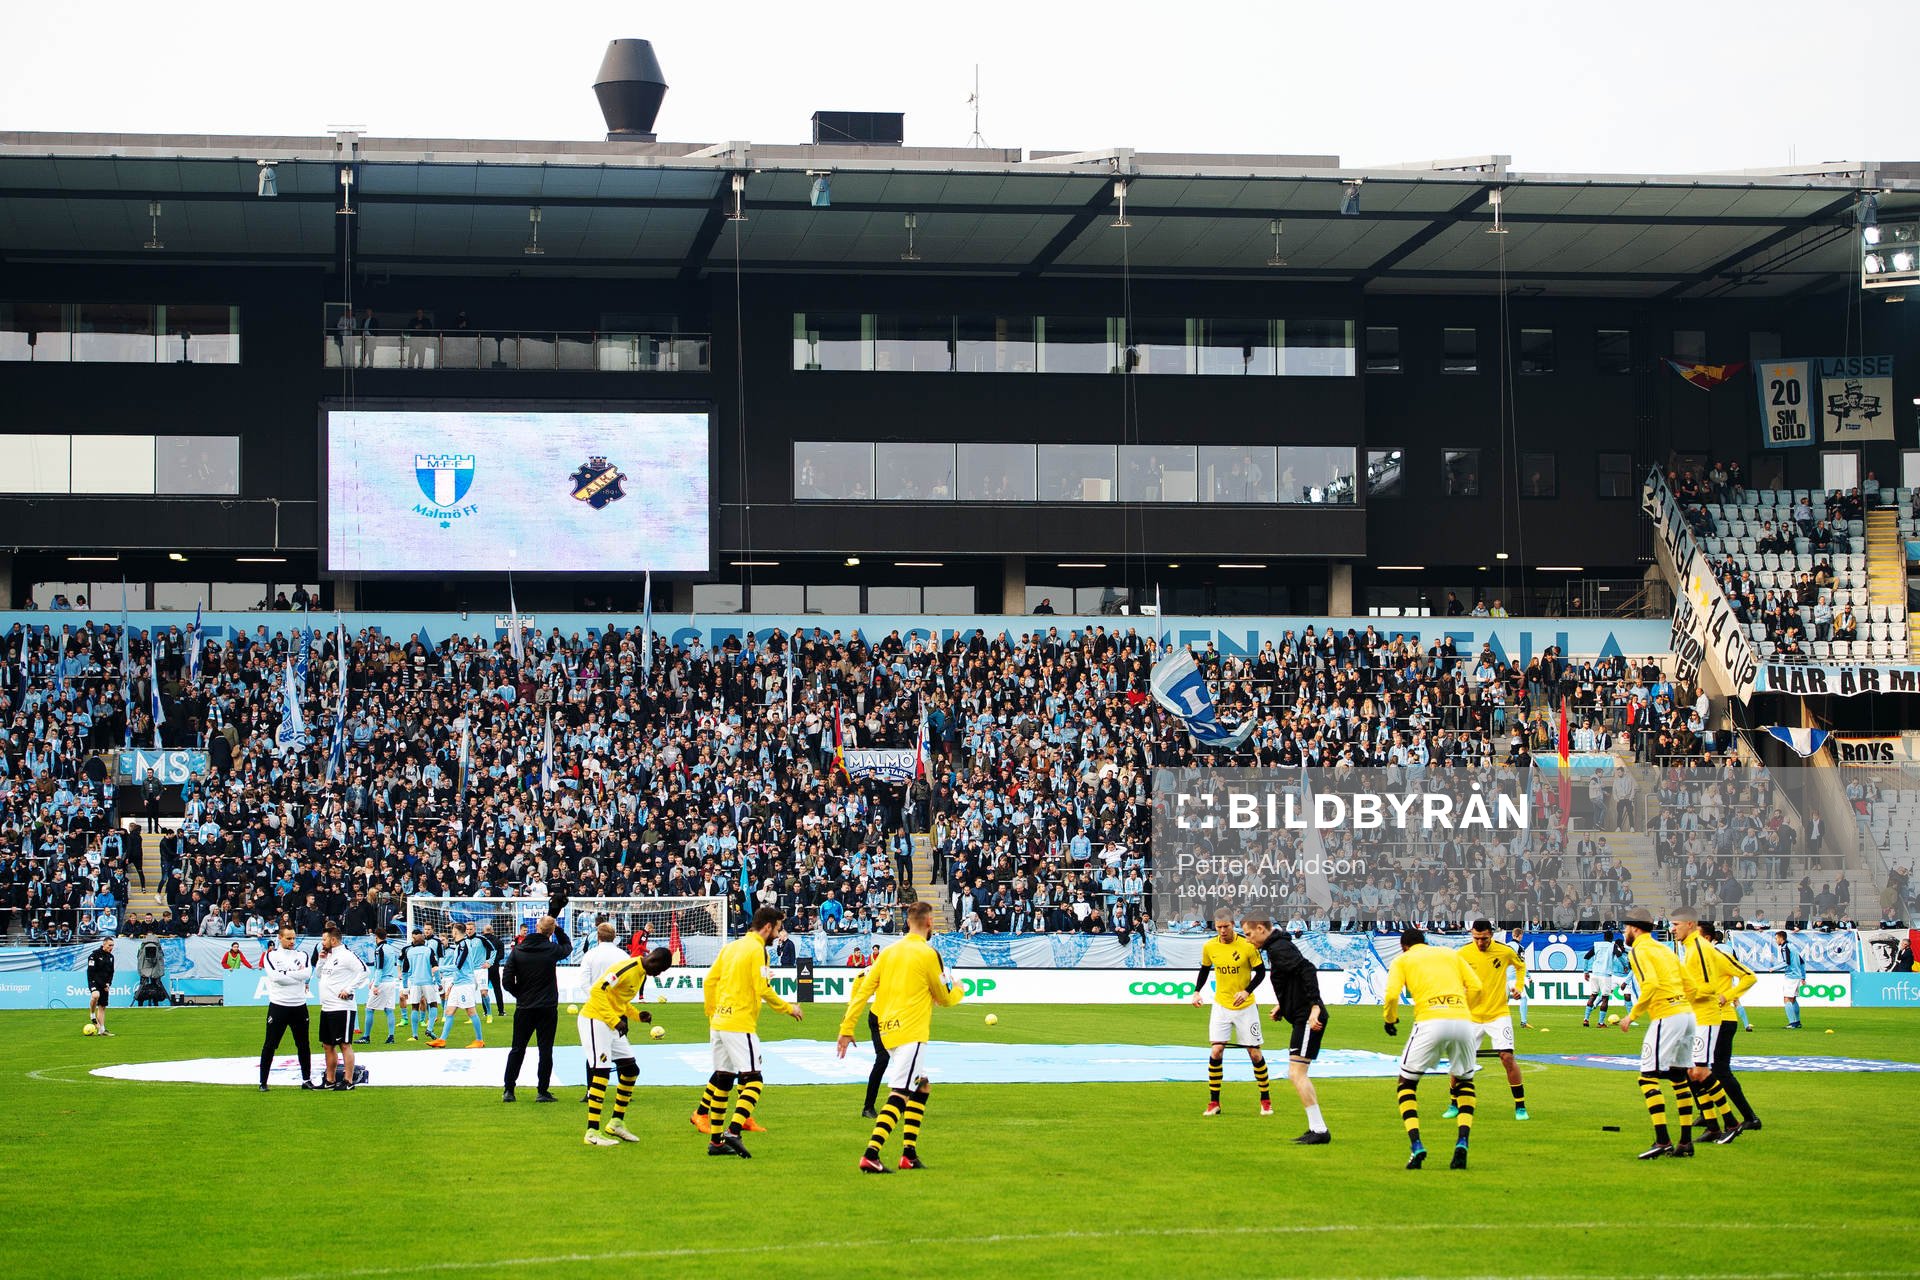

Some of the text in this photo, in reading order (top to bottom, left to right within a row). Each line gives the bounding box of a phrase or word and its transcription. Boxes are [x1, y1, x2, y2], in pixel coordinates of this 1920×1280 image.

[1821, 357, 1890, 377] LASSE
[1771, 379, 1801, 406] 20
[1777, 409, 1797, 425] SM
[1773, 423, 1806, 441] GULD
[412, 503, 479, 519] Malmö FF
[1665, 505, 1697, 593] LIGA
[1706, 596, 1729, 648] 14
[1725, 629, 1757, 695] CUP
[1767, 665, 1920, 695] HÄR ÄR M
[135, 750, 190, 783] MS
[849, 751, 915, 768] MALMÖ
[1216, 964, 1240, 975] notar
[66, 984, 131, 996] Sweank
[1129, 982, 1196, 998] coop
[1539, 982, 1590, 1000] TILL
[1799, 985, 1846, 1001] oop
[1882, 981, 1920, 1001] mff.s
[1428, 996, 1464, 1005] SVEA
